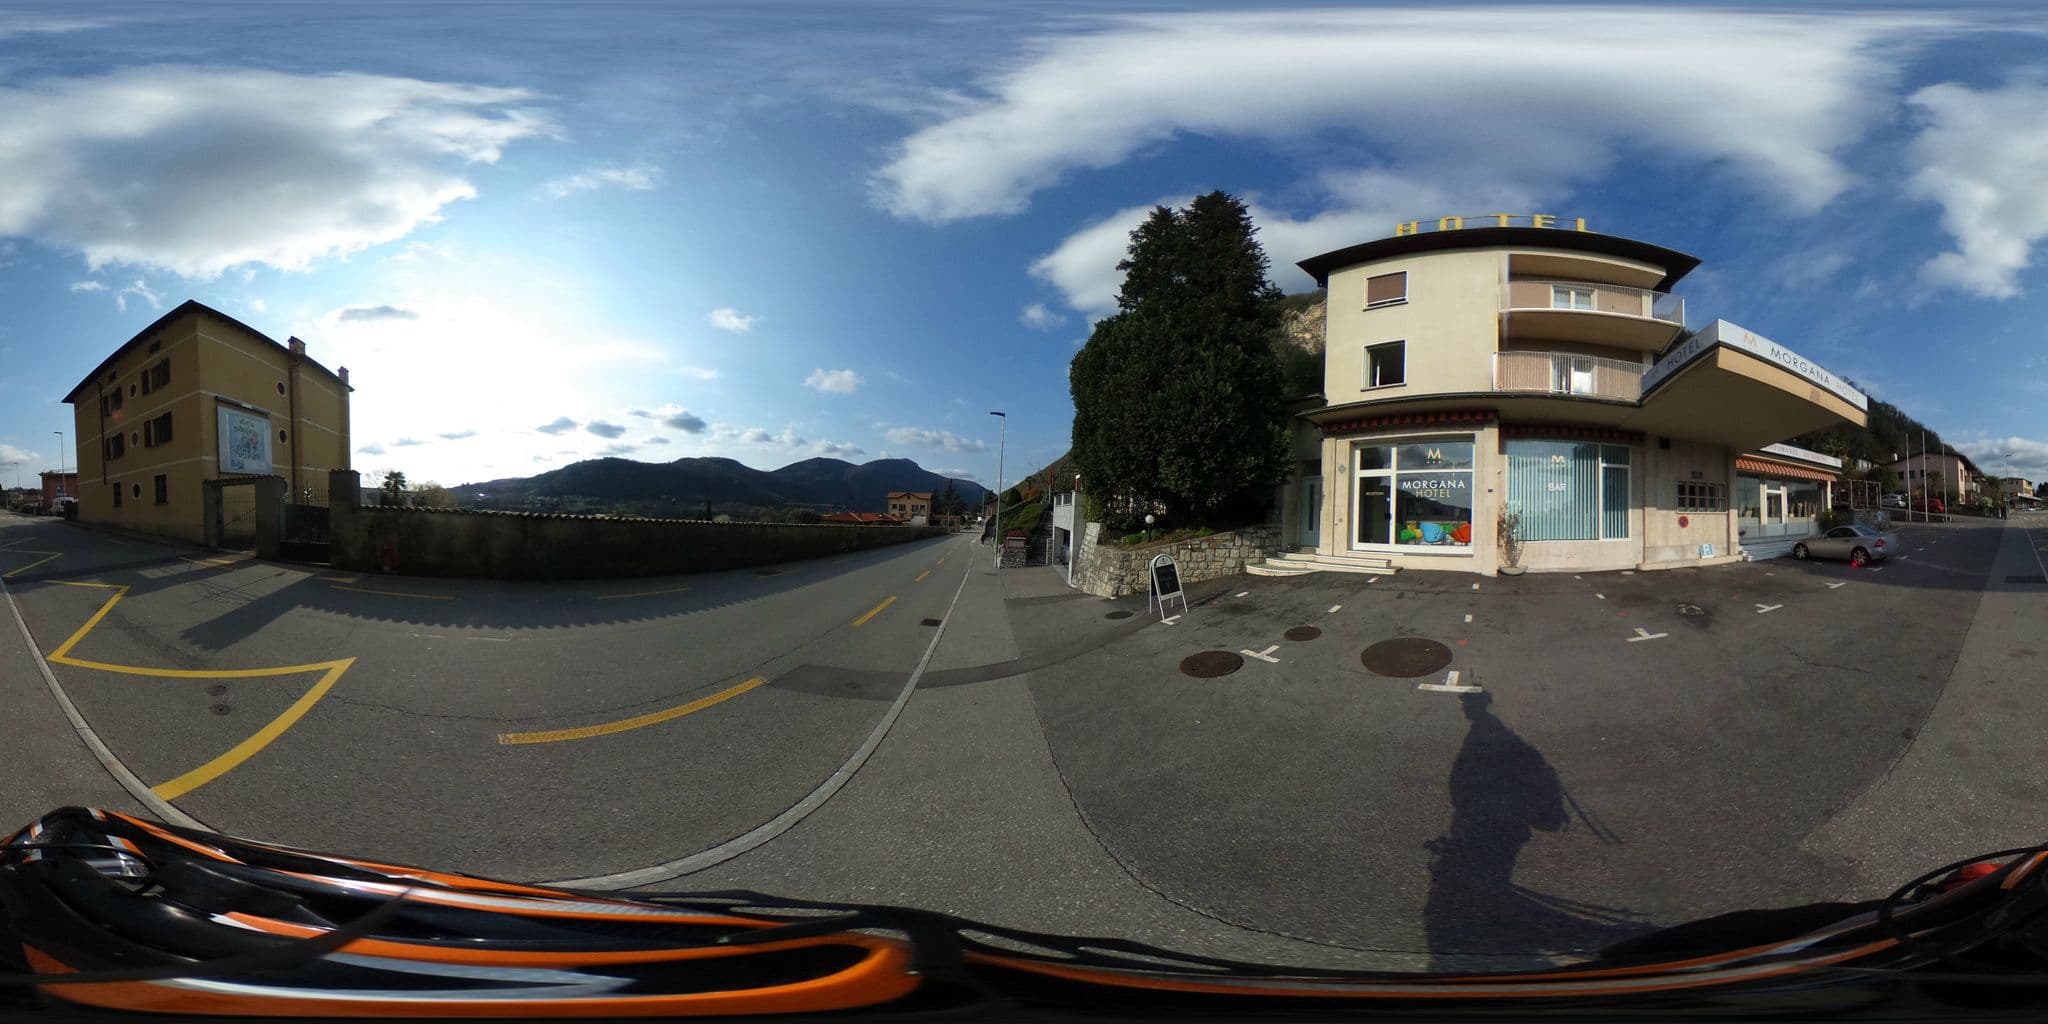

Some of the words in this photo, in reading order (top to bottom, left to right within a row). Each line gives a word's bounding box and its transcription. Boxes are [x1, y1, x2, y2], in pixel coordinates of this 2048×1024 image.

[1396, 213, 1600, 236] HOTEL
[1666, 338, 1702, 370] HOTEL
[1770, 346, 1830, 385] MORGANA
[1402, 480, 1466, 489] MORGANA
[1548, 482, 1567, 491] BAR
[1415, 489, 1452, 498] HOTEL
